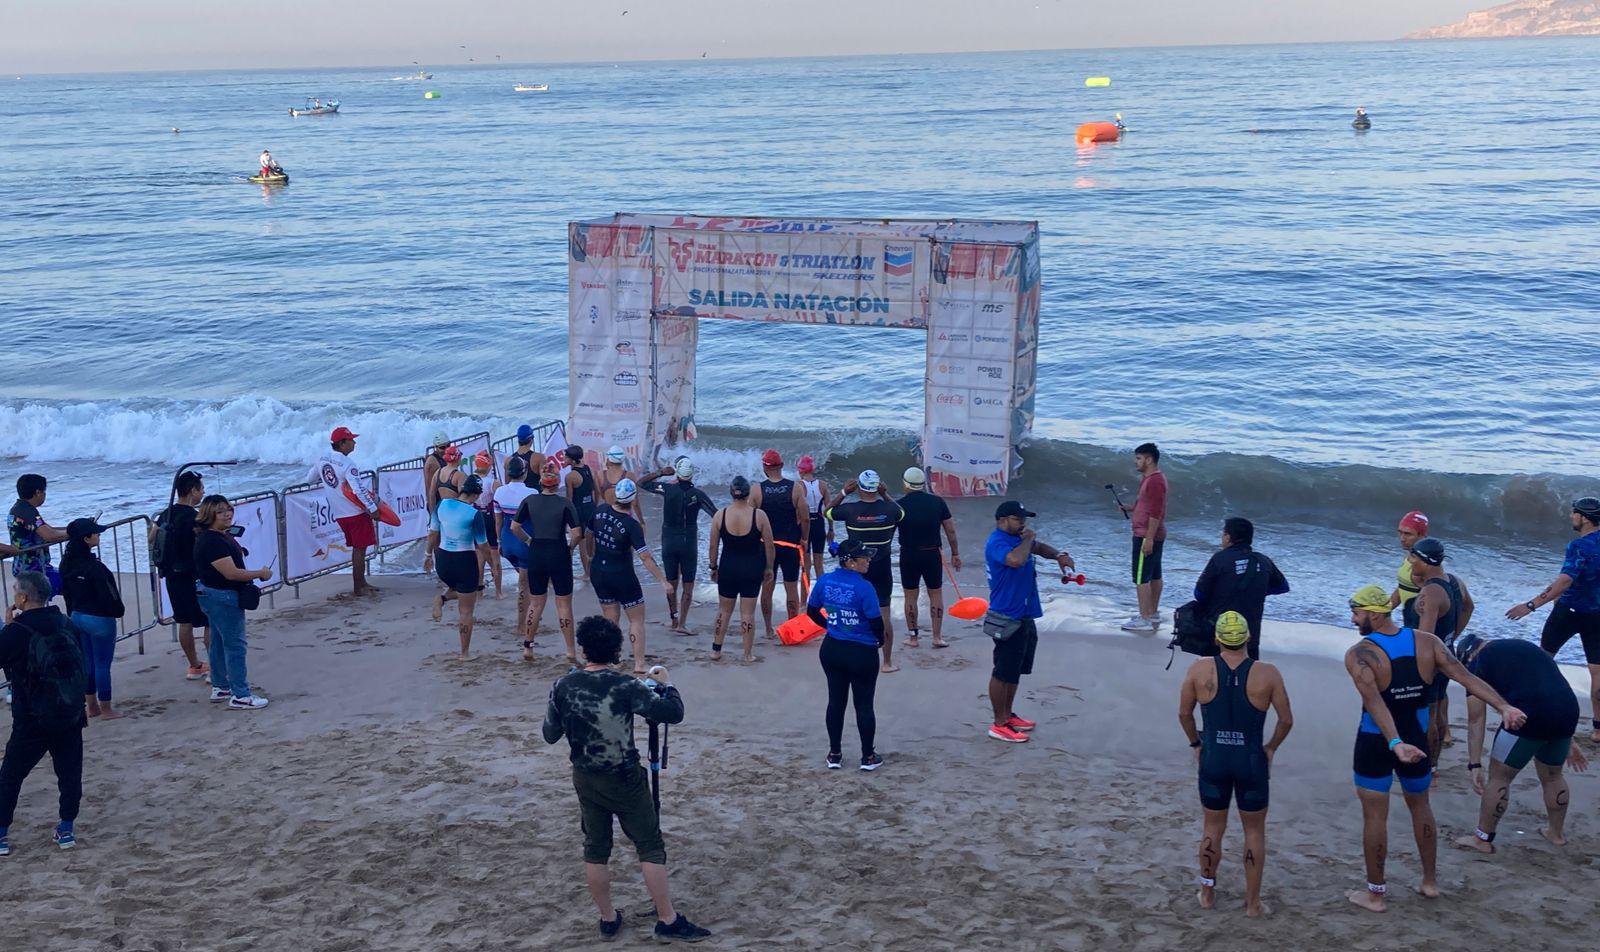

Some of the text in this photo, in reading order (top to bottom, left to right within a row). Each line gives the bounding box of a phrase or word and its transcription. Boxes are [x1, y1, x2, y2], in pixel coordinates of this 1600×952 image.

[812, 272, 875, 281] SKECHERS
[688, 288, 890, 314] SALIDA NATACIÓN
[397, 494, 426, 514] TURISMO
[1245, 848, 1256, 867] A
